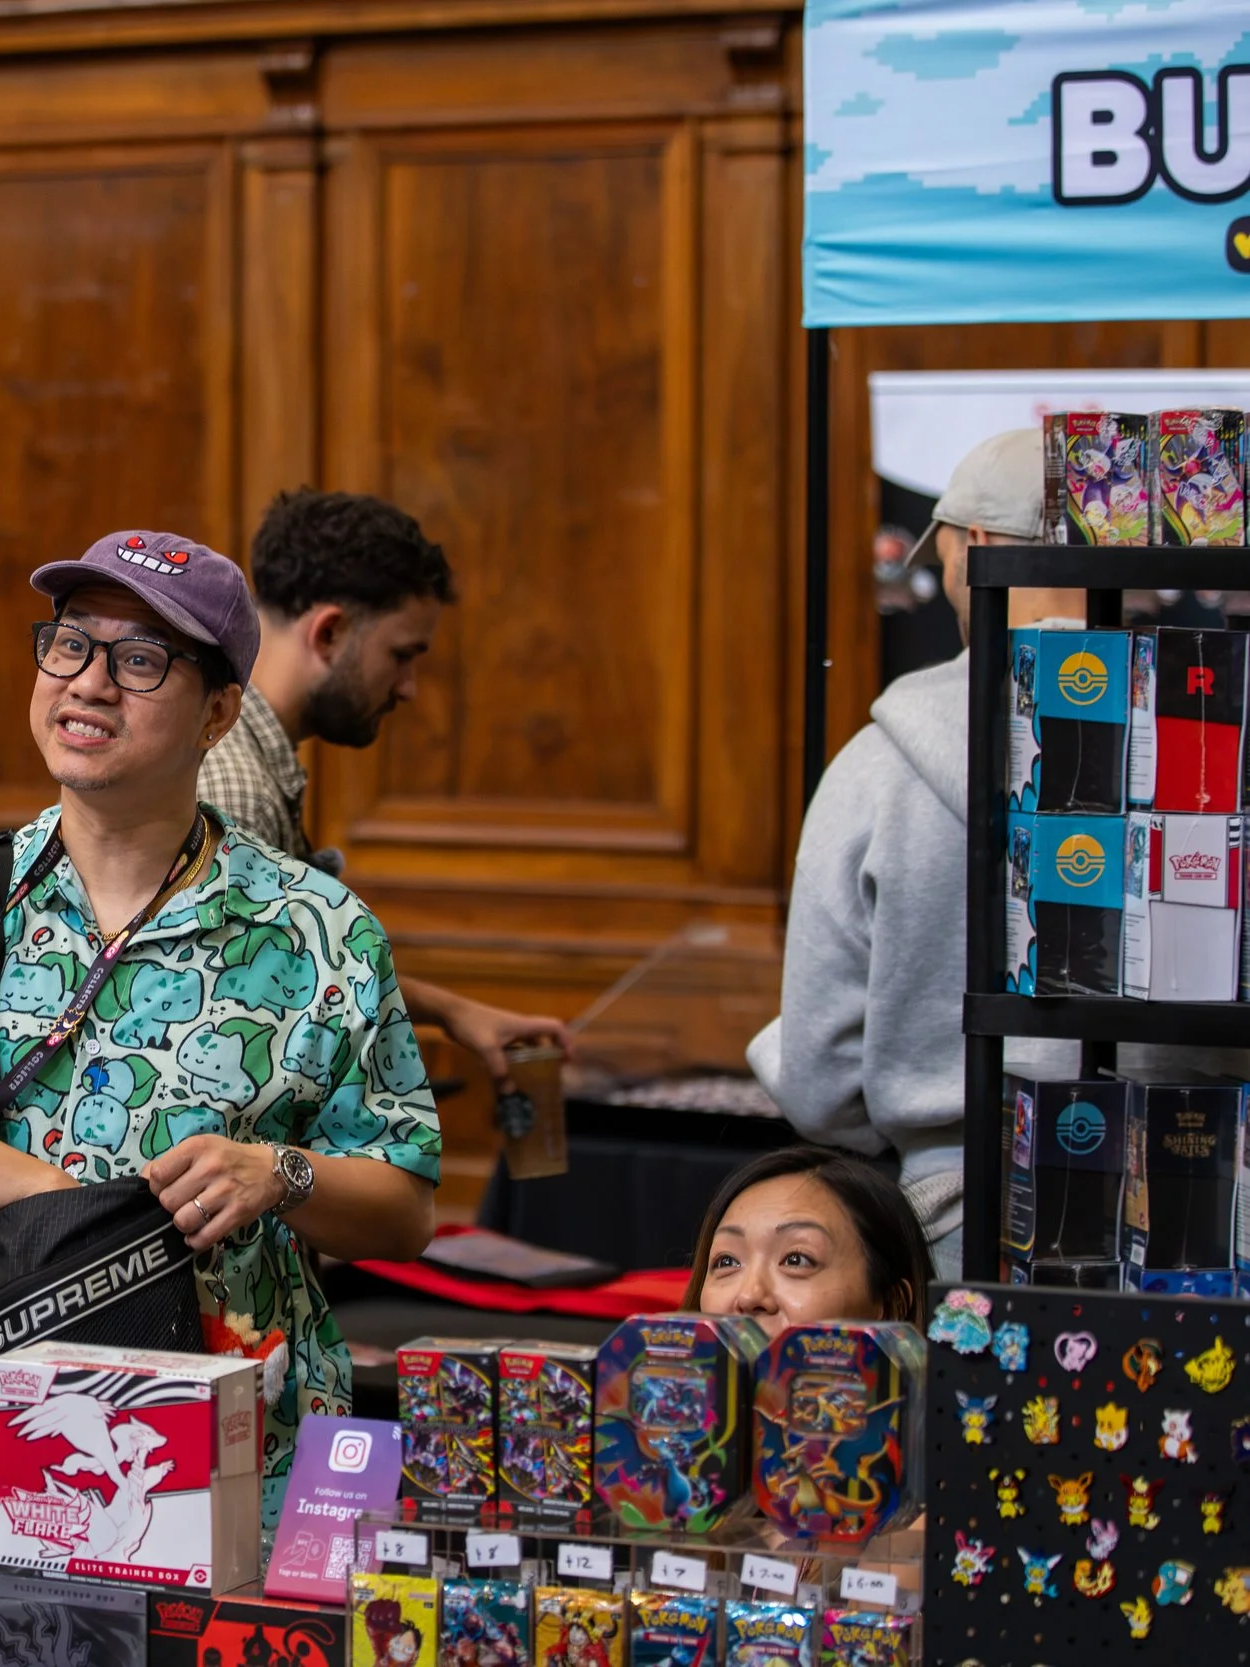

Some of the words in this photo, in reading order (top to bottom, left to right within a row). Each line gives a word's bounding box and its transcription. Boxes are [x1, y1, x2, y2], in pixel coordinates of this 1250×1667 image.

[1187, 667, 1215, 695] R
[314, 1487, 342, 1498] Follow
[343, 1491, 354, 1499] us
[355, 1492, 367, 1501] on
[10, 1500, 80, 1524] WHITE
[296, 1498, 364, 1522] Instagra
[12, 1519, 72, 1541] FLARE
[75, 1562, 103, 1573] ELITE
[108, 1566, 154, 1578] TRAINER
[158, 1571, 179, 1581] BOX
